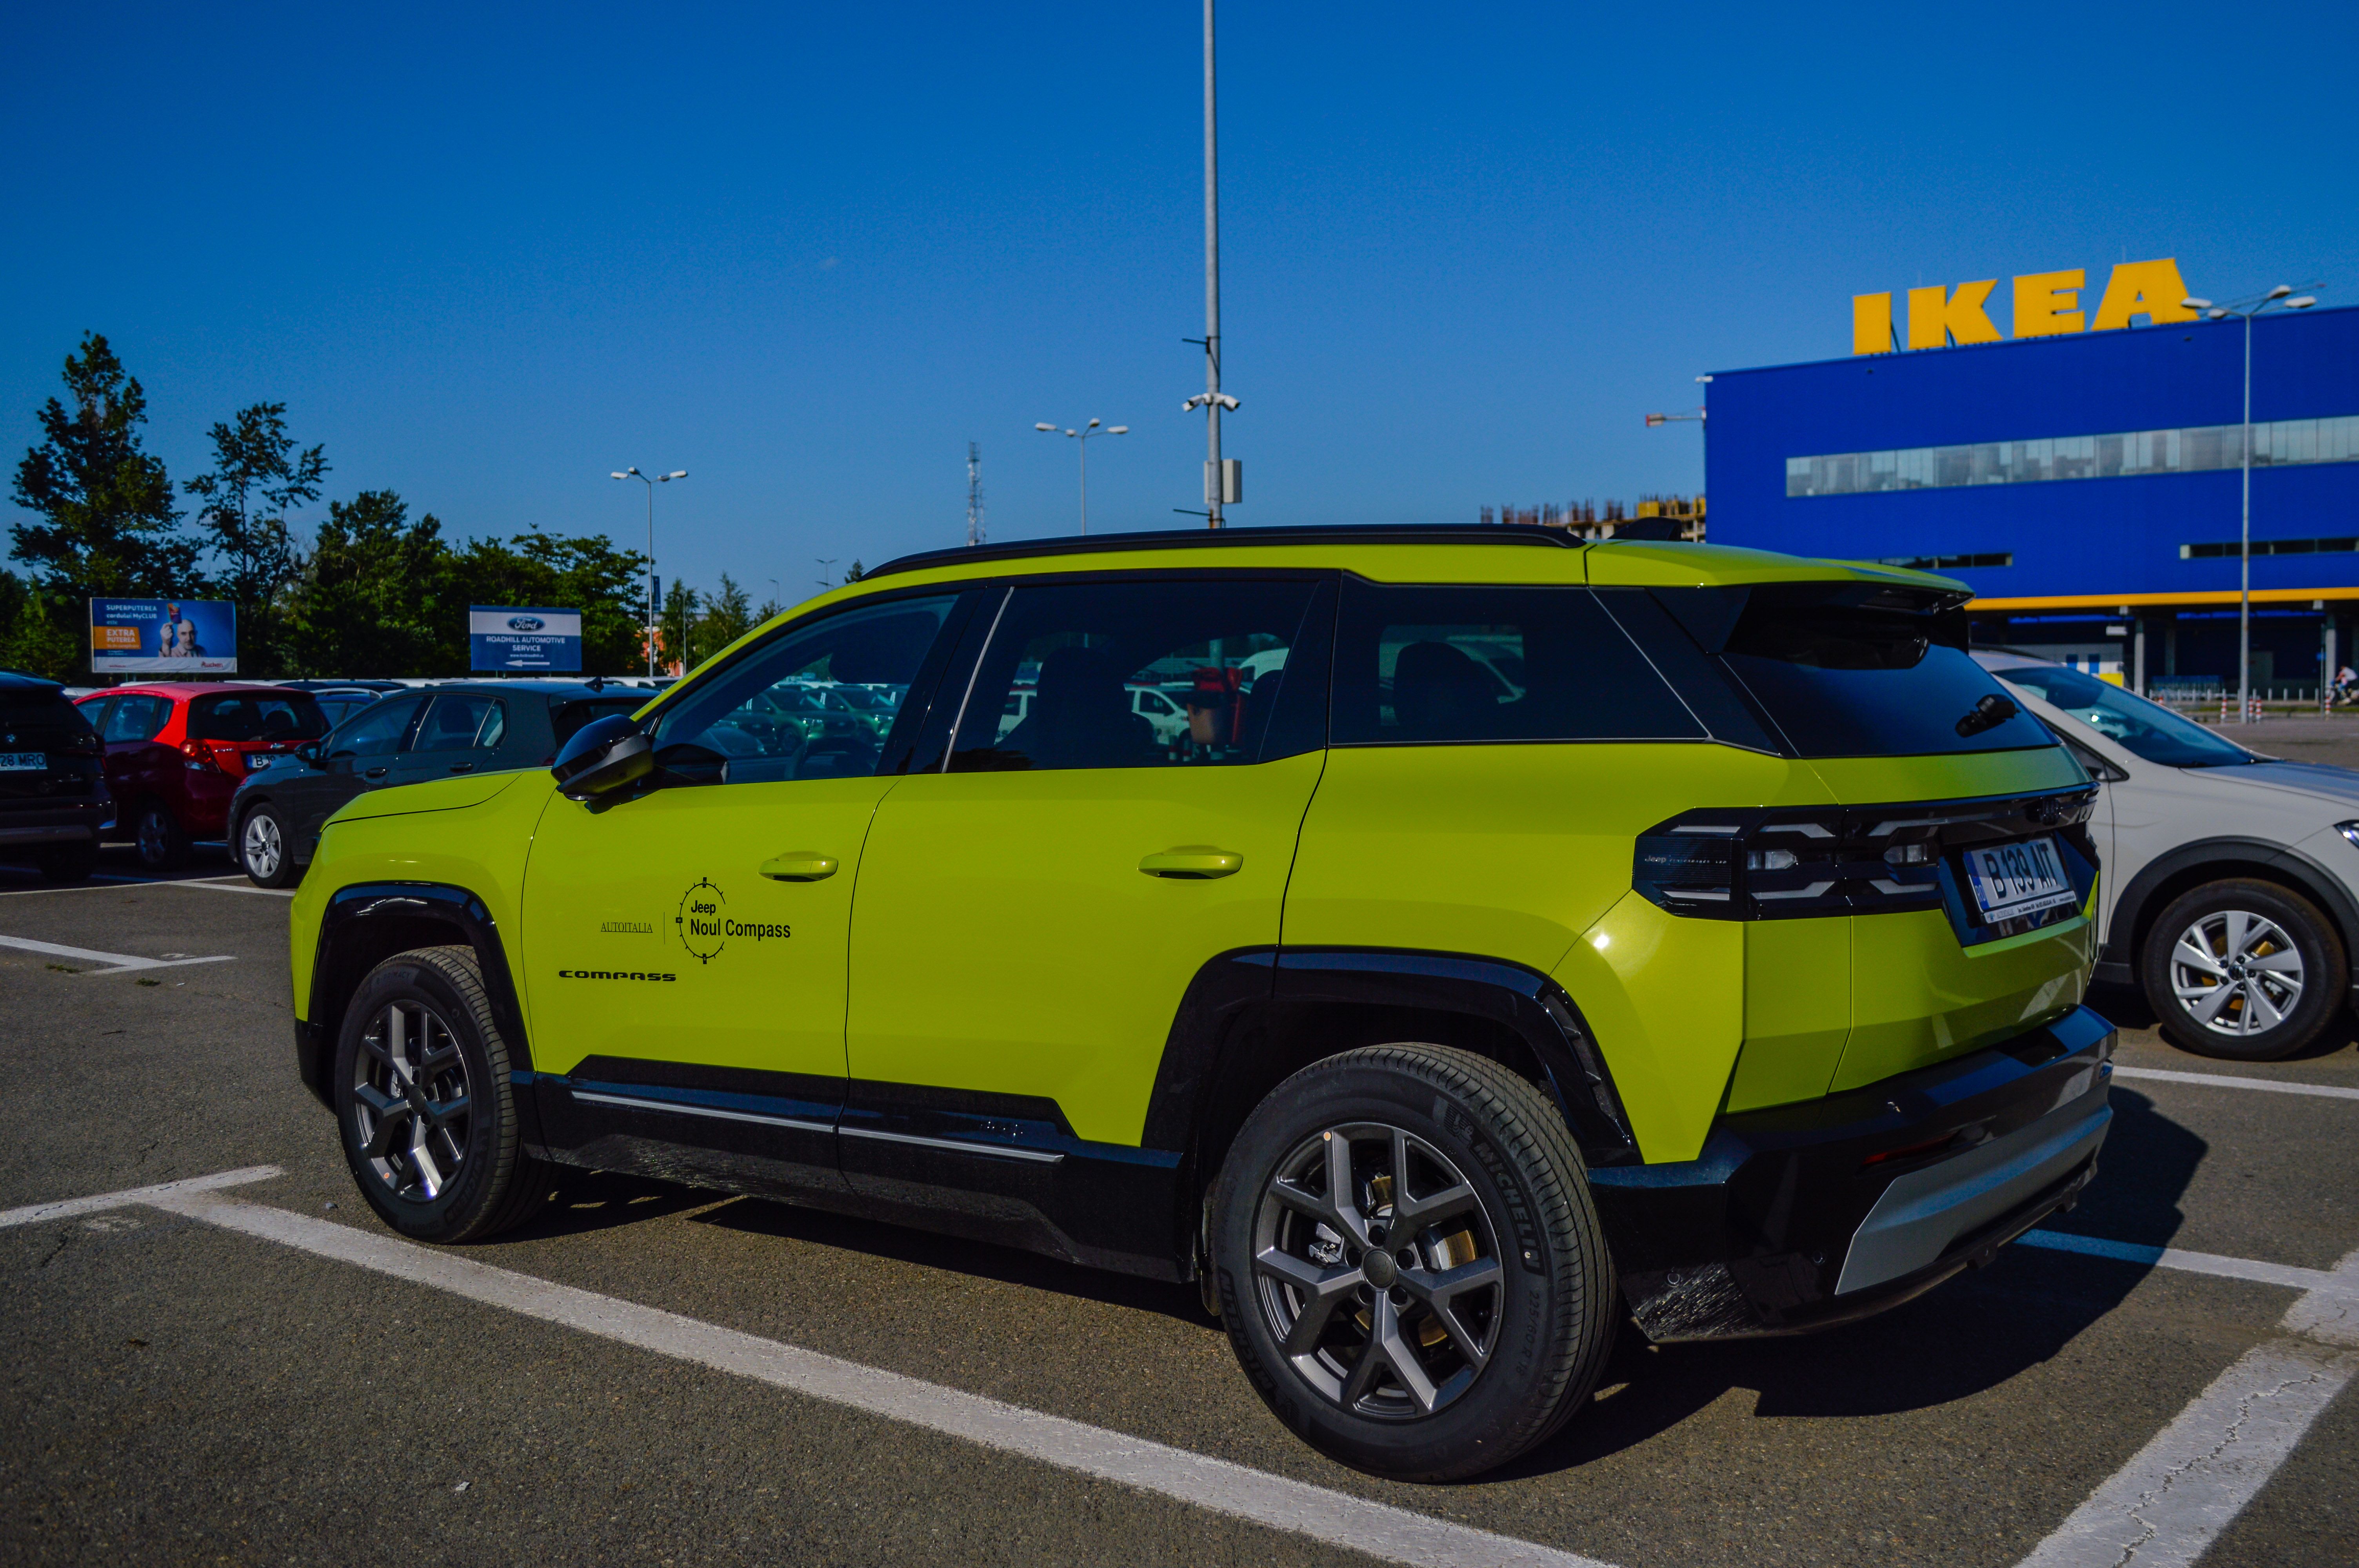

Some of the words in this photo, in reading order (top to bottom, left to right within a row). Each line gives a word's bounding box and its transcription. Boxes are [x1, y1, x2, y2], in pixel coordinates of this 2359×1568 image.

[1853, 257, 2200, 355] IKEA
[514, 617, 538, 629] Ford
[19, 754, 45, 766] MRO
[255, 755, 264, 766] B
[1645, 855, 1667, 864] Jeep
[1983, 853, 2007, 899] B
[2001, 848, 2035, 895] 139
[2030, 843, 2058, 888] AIT
[691, 900, 716, 916] Jeep
[601, 922, 653, 933] AUTOITALIA
[691, 918, 721, 936] Noul
[725, 919, 791, 941] Compass
[559, 970, 677, 982] COMPASS
[1472, 1141, 1541, 1269] MICHELIN
[1525, 1289, 1540, 1344] 225/60
[1218, 1267, 1274, 1391] MICHELIN
